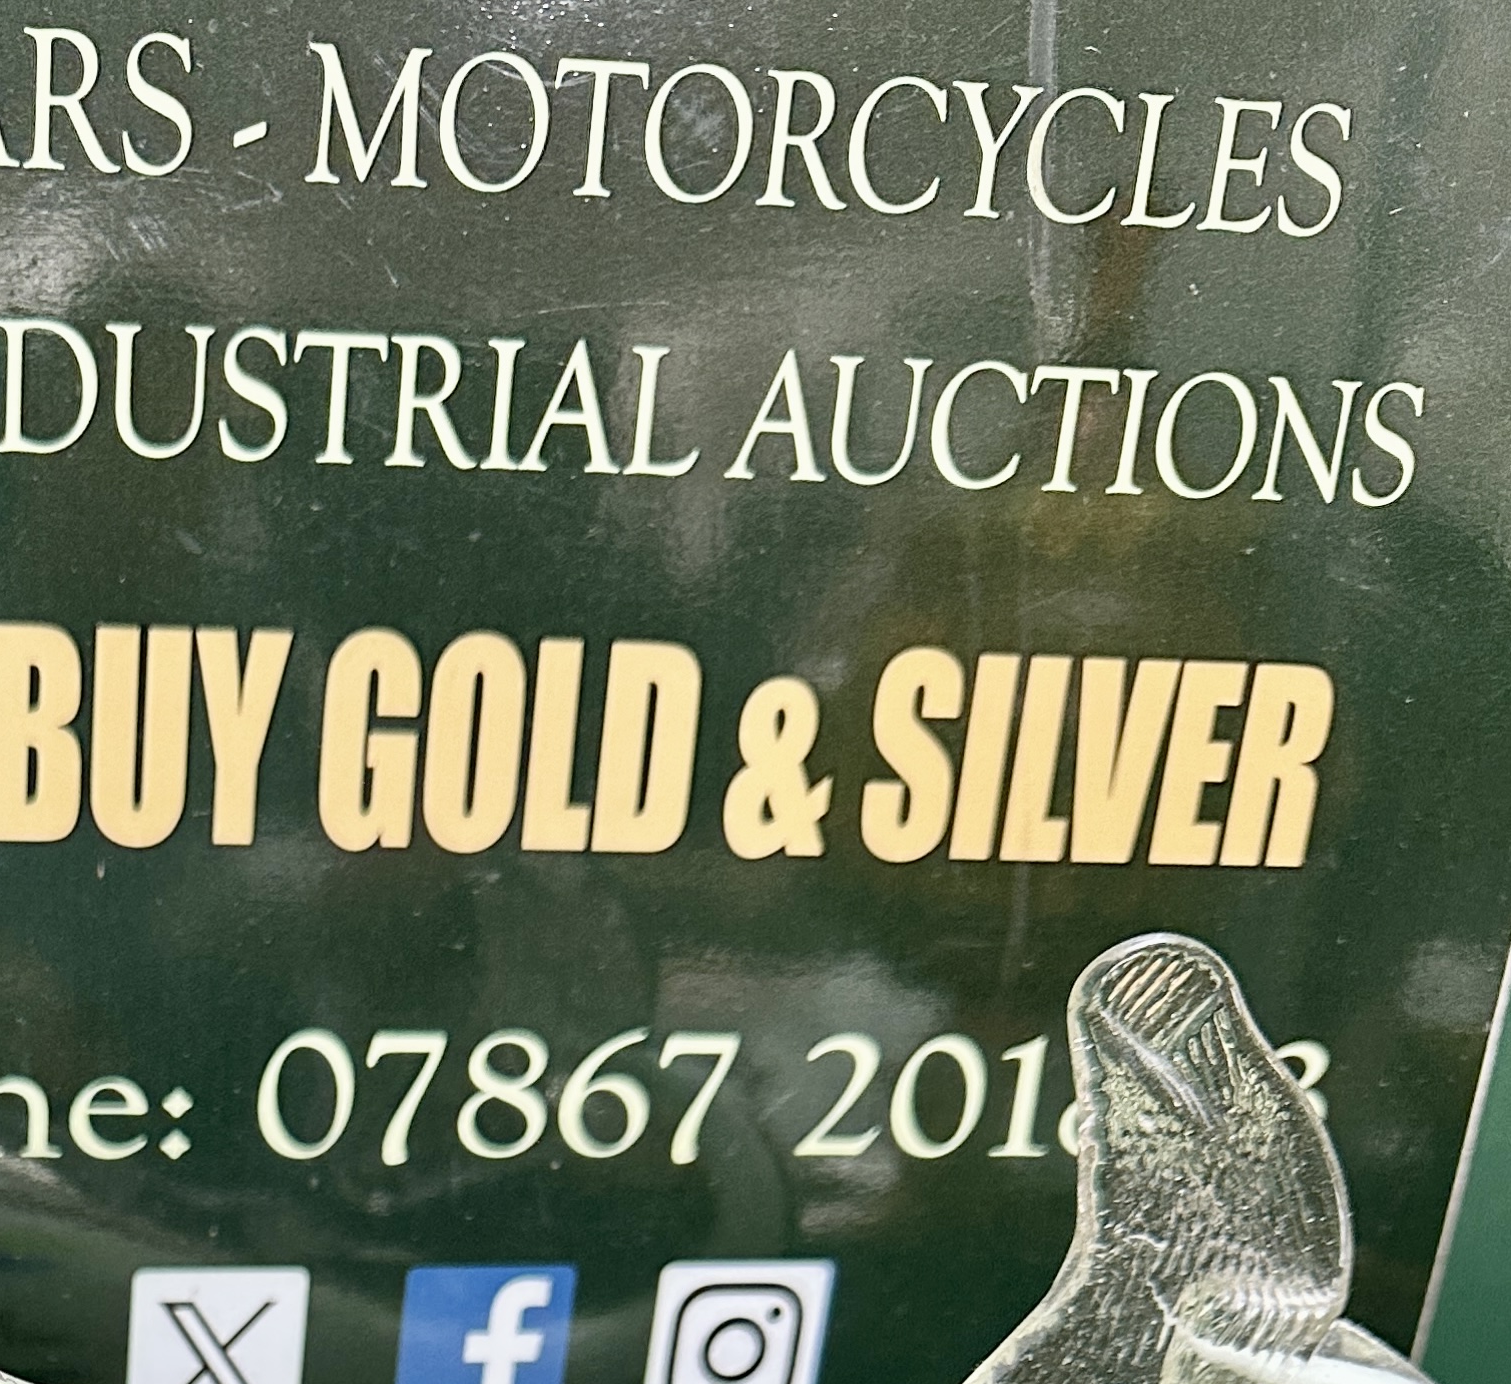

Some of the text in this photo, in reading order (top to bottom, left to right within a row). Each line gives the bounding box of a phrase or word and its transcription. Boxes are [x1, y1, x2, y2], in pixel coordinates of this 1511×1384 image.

[230, 118, 270, 150] -
[302, 38, 1353, 240] MOTORCYCLES
[721, 347, 1427, 509] AUCTIONS
[317, 628, 702, 855] GOLD
[721, 676, 834, 861] &
[859, 646, 1335, 870] SILVER
[256, 1029, 742, 1168] 07867
